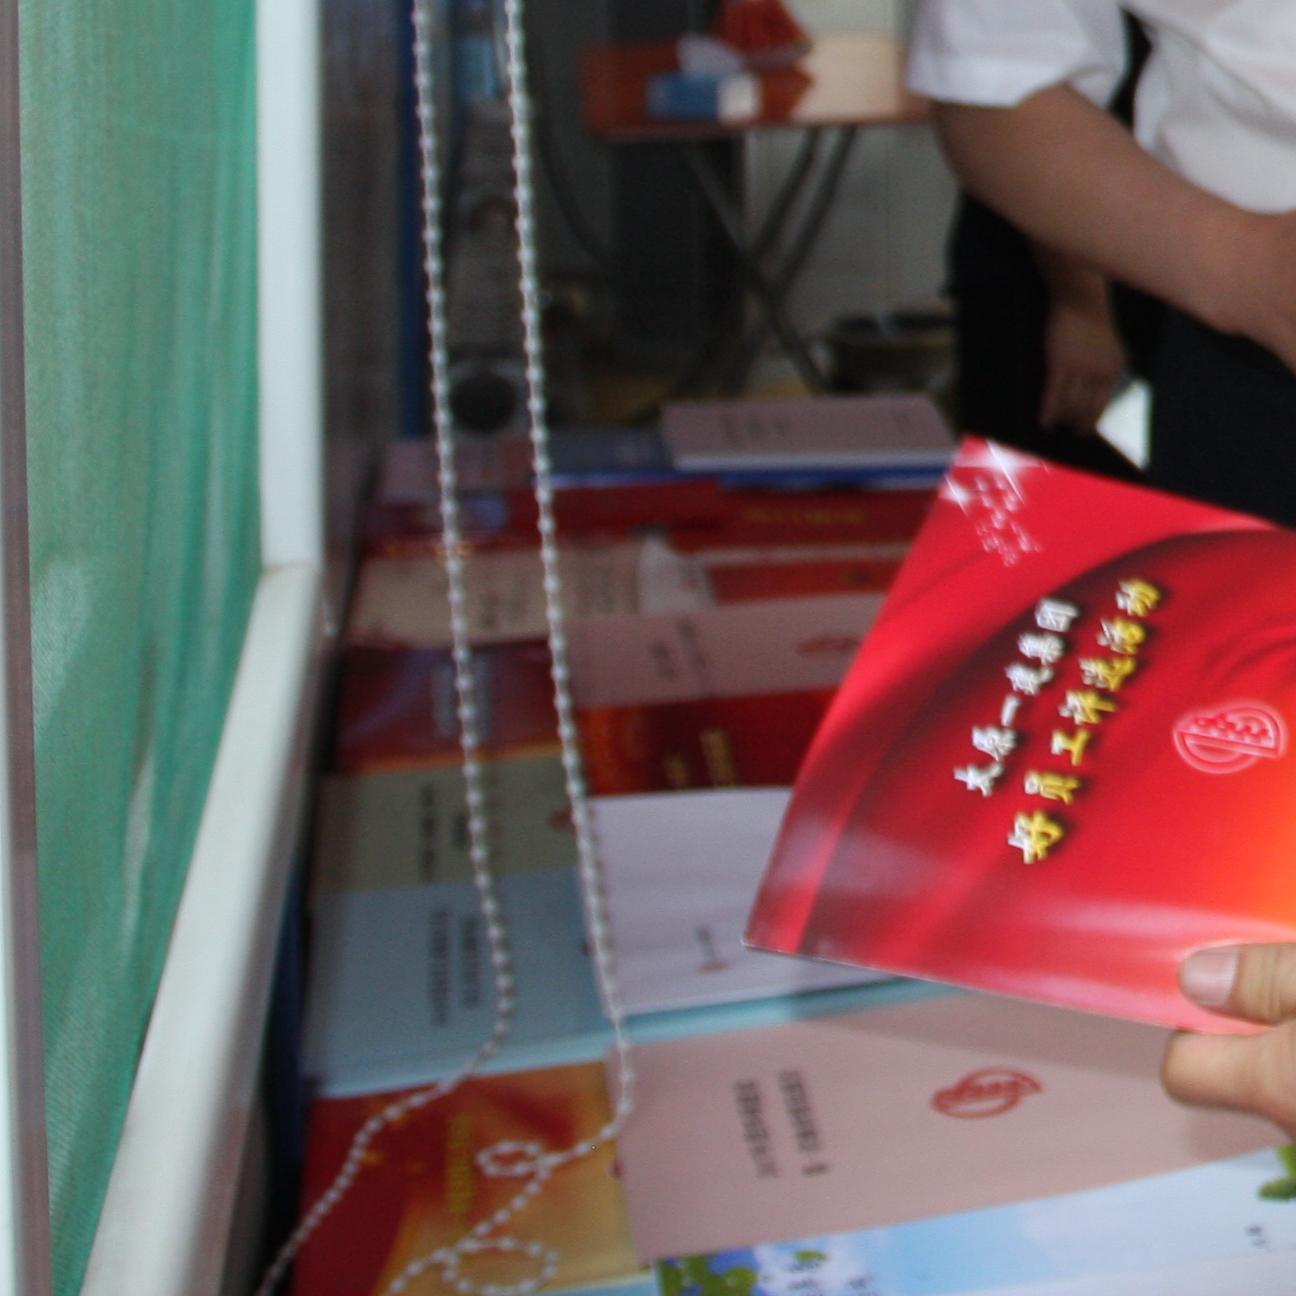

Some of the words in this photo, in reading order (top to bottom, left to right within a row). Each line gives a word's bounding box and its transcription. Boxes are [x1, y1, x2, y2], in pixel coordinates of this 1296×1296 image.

[954, 597, 1080, 797] 太原一建集团
[1008, 578, 1161, 864] 好员工评选活动
